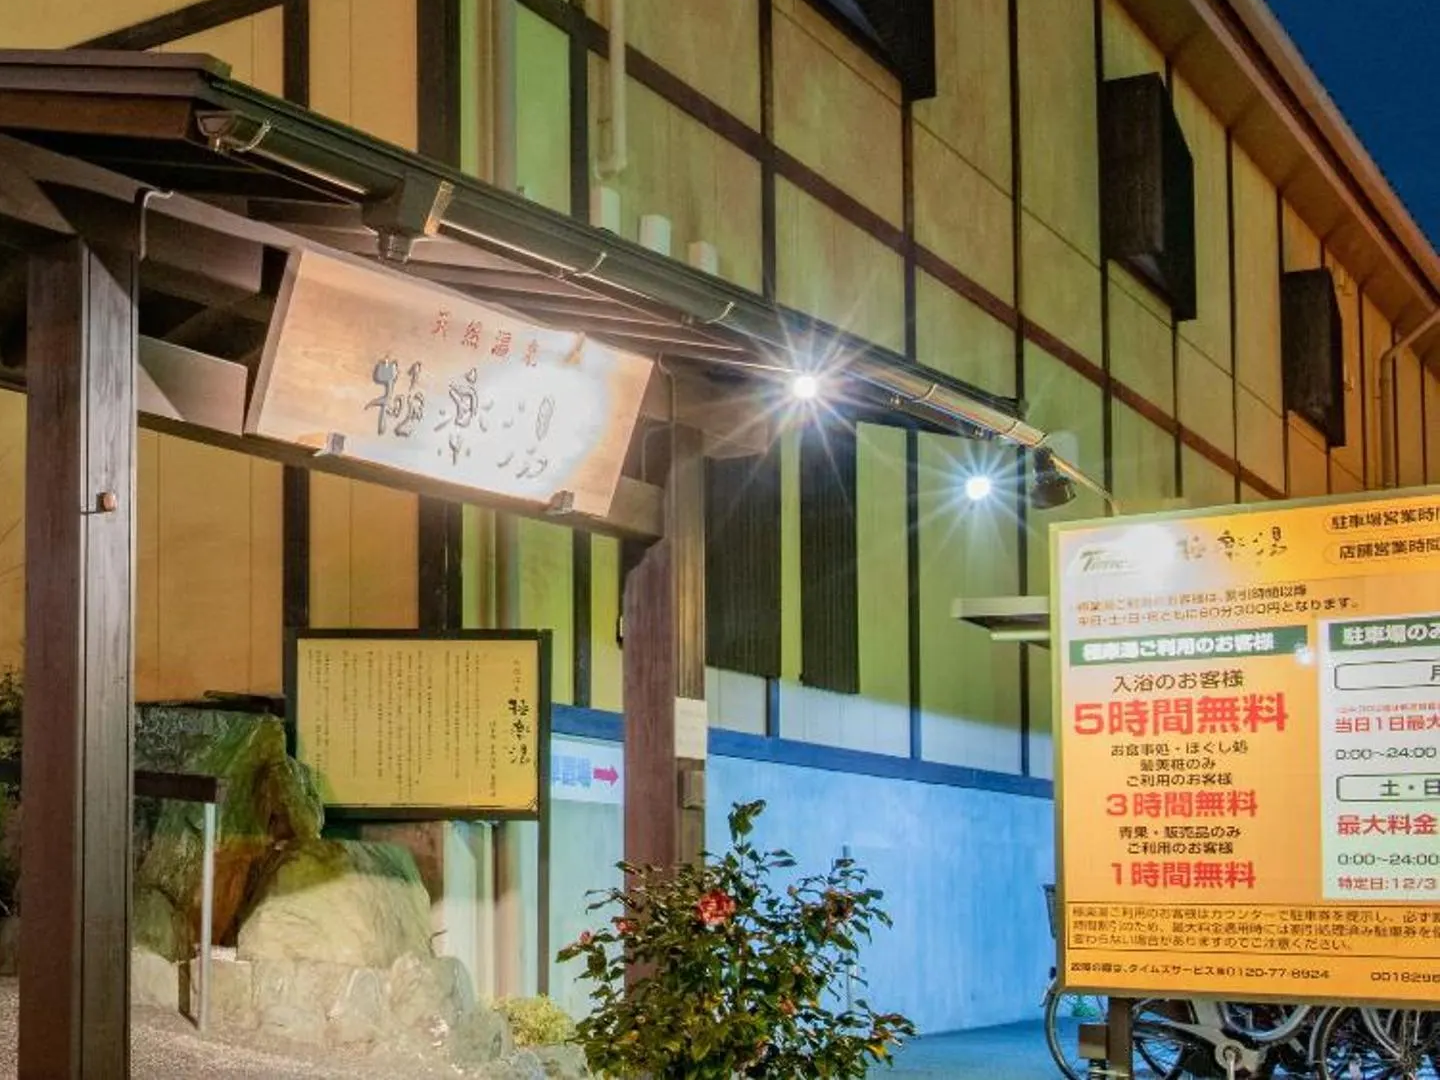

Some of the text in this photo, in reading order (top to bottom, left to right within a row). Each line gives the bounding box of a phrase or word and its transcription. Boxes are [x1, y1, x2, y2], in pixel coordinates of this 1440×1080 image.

[1331, 506, 1440, 530] 駐車場営業時
[1112, 668, 1244, 694] 入浴のお客様
[1073, 691, 1288, 738] 5時間無料
[1110, 739, 1249, 757] お食事処・ほぐし処
[1126, 772, 1233, 788] ご利用のお客様
[1105, 789, 1259, 818] 3時間無料
[1337, 813, 1439, 836] 最大料金
[1127, 841, 1234, 855] ご利用のお客様
[1110, 860, 1257, 890] 1時間無料
